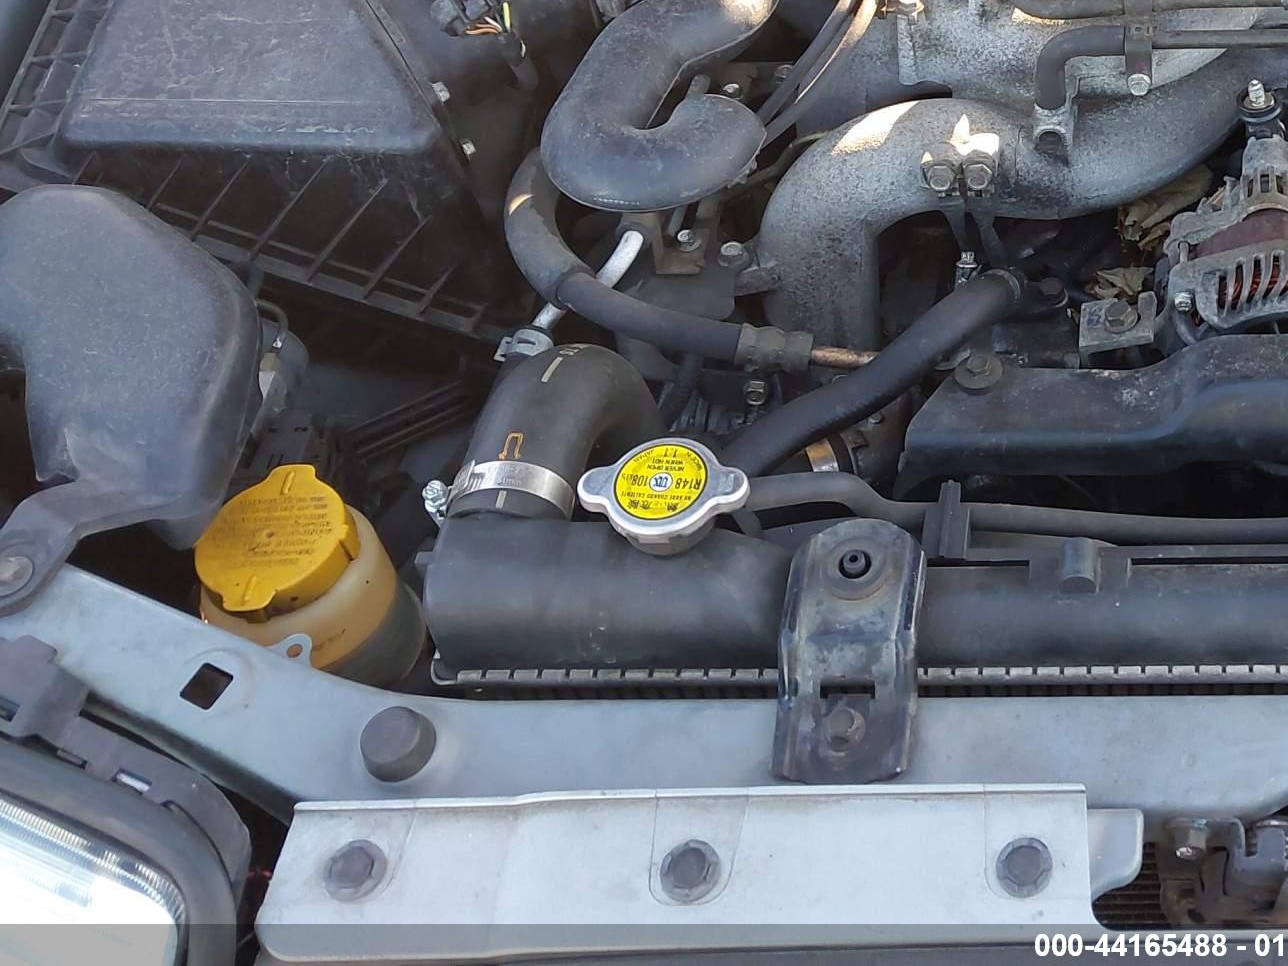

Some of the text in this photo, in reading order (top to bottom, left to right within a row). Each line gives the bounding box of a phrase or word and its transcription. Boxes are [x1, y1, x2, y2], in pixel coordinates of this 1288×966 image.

[664, 447, 679, 458] 1.1
[651, 457, 684, 466] WHEN HOT
[646, 463, 685, 472] NEVER OPEN
[674, 477, 703, 490] R148
